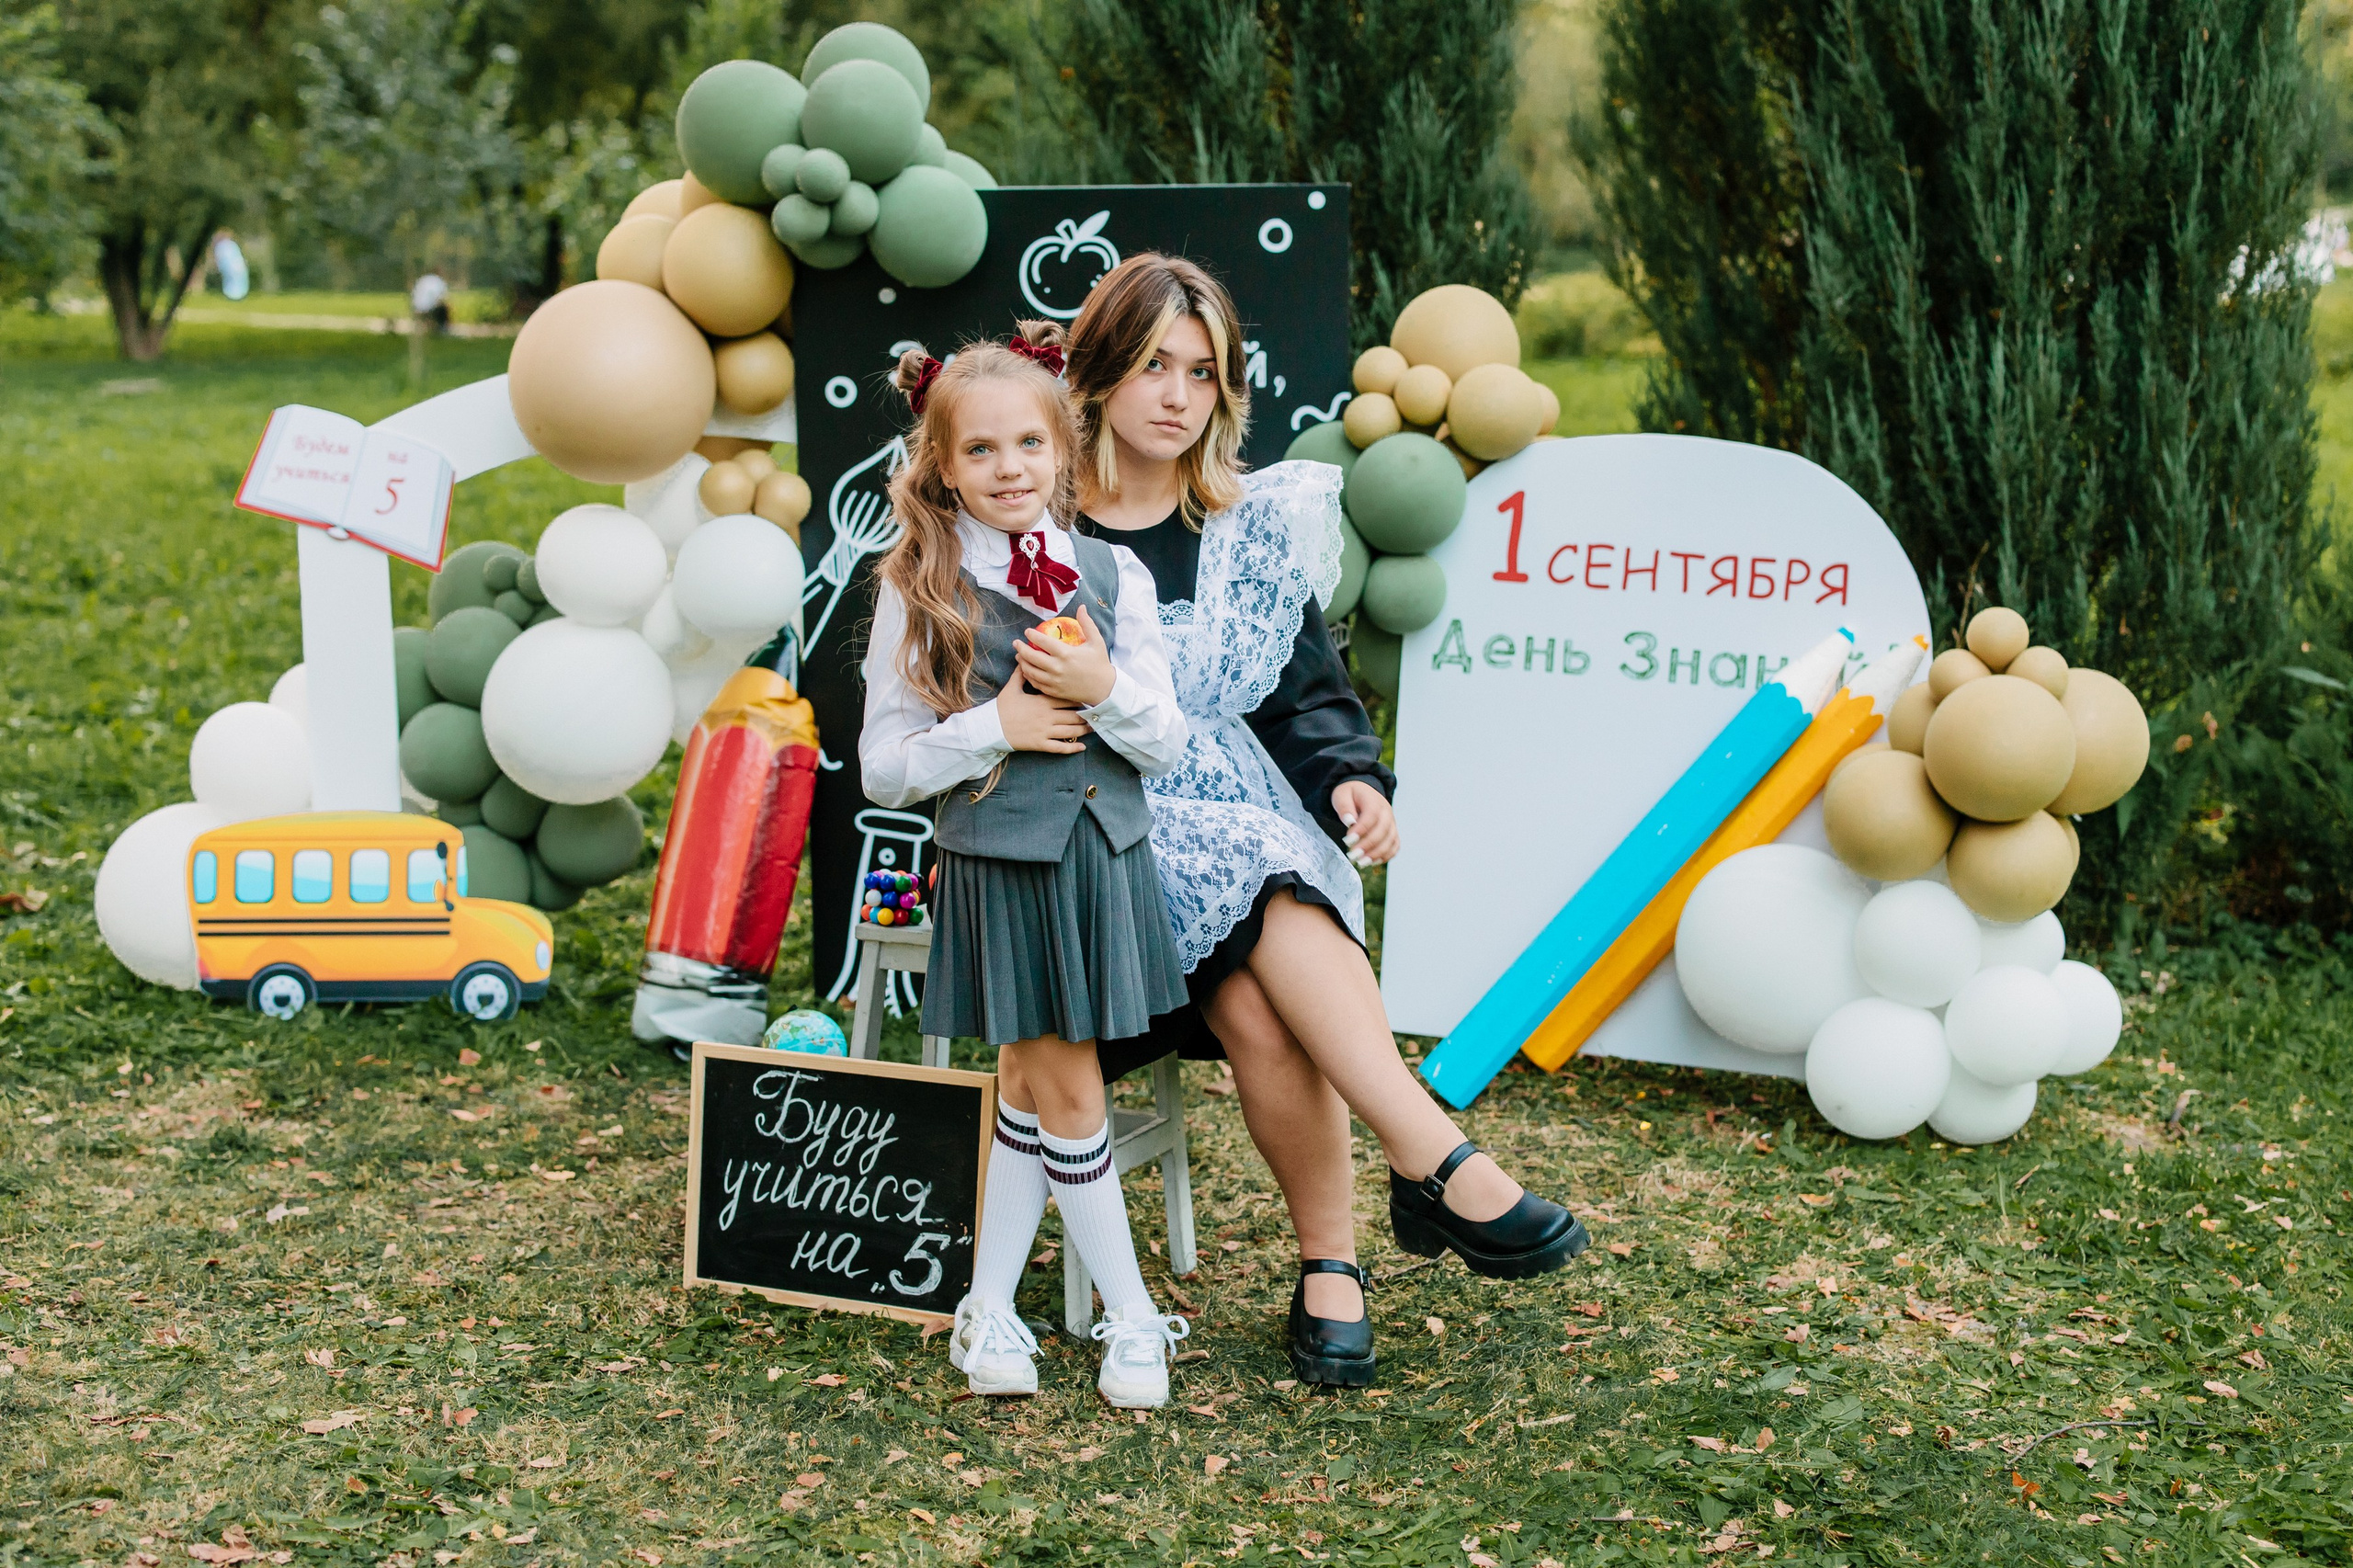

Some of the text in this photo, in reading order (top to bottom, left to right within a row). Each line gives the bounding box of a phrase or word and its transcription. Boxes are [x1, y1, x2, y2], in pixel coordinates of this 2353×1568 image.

[375, 478, 405, 515] 5
[1492, 490, 1849, 607] 1 СЕНТЯБРЯ
[1431, 617, 1592, 676] День
[752, 1069, 900, 1176] Буду
[718, 1158, 946, 1233] учиться
[790, 1230, 870, 1279] на
